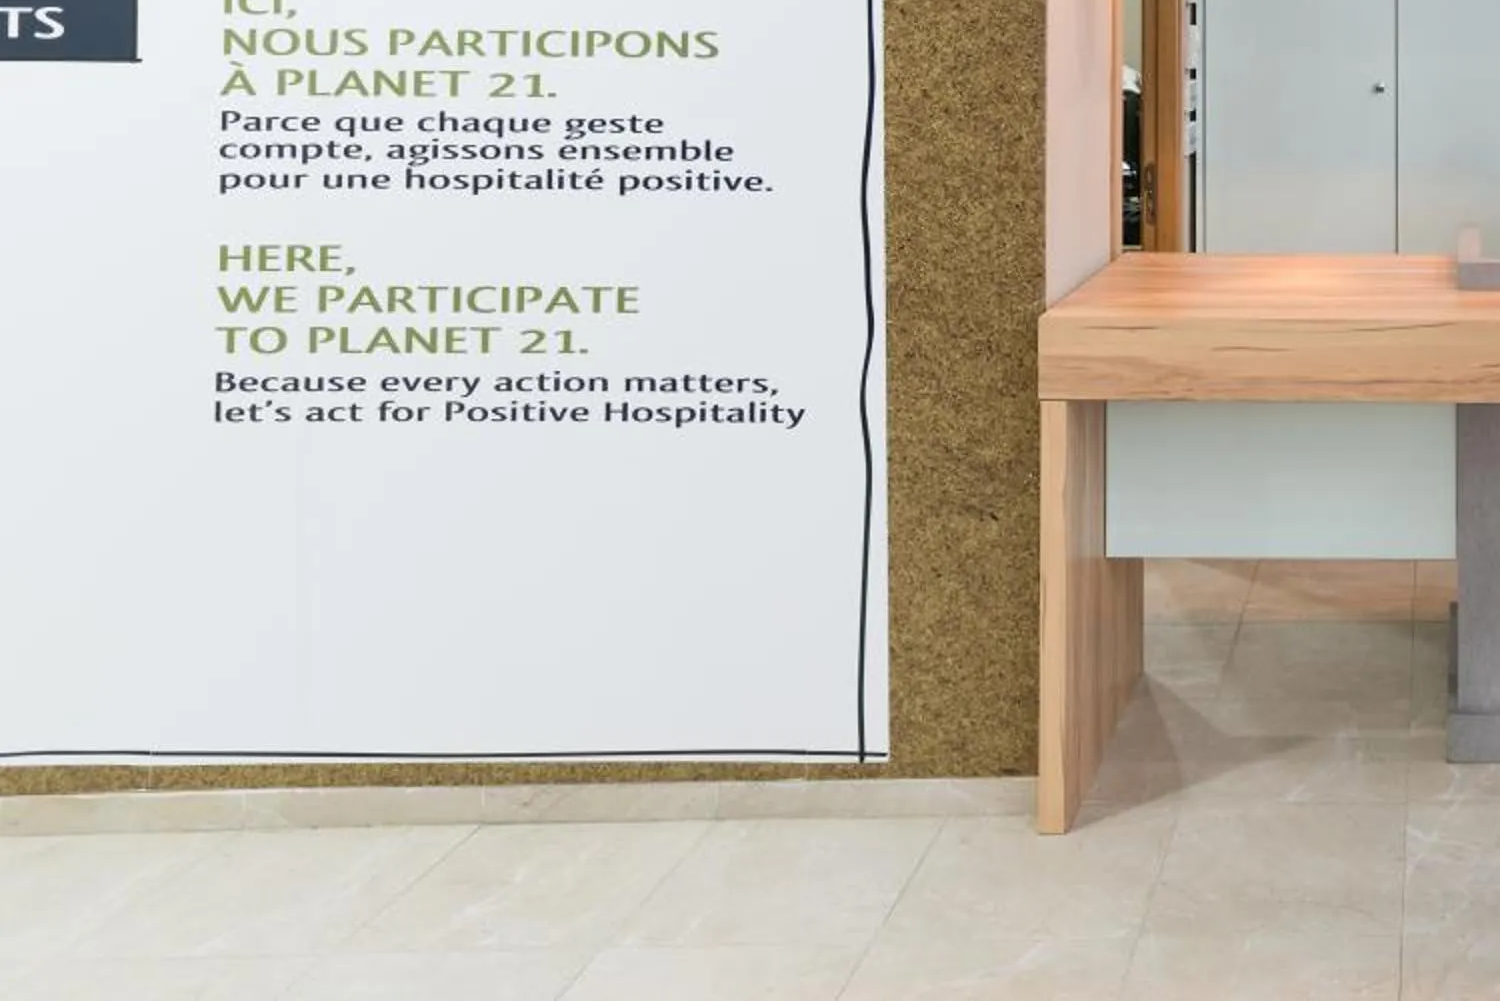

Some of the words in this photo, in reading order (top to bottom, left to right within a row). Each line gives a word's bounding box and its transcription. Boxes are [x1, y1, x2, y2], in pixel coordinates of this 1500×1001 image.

[222, 28, 369, 57] NOUS
[388, 28, 720, 60] PARTICIPONS
[220, 61, 257, 98] À
[276, 69, 471, 99] PLANET
[488, 72, 557, 99] 21.
[220, 109, 321, 133] Parce
[333, 116, 404, 138] que
[416, 110, 552, 139] chaque
[563, 115, 665, 140] geste
[218, 140, 373, 165] compte,
[385, 138, 545, 167] agissons
[557, 139, 735, 162] ensemble
[218, 172, 310, 195] pour
[322, 173, 391, 190] une
[404, 167, 605, 196] hospitalité
[618, 169, 774, 197] positive.
[219, 244, 356, 277] HERE,
[217, 285, 298, 314] WE
[317, 285, 640, 315] PARTICIPATE
[215, 326, 288, 355] TO
[308, 326, 502, 356] PLANET
[519, 328, 589, 356] 21.
[215, 371, 367, 394] Because
[379, 375, 481, 399] every
[493, 370, 609, 394] action
[624, 373, 779, 398] matters,
[214, 399, 292, 424] let’s
[304, 402, 364, 424] act
[377, 399, 432, 423] for
[444, 399, 590, 424] Positive
[603, 400, 807, 430] Hospitality
